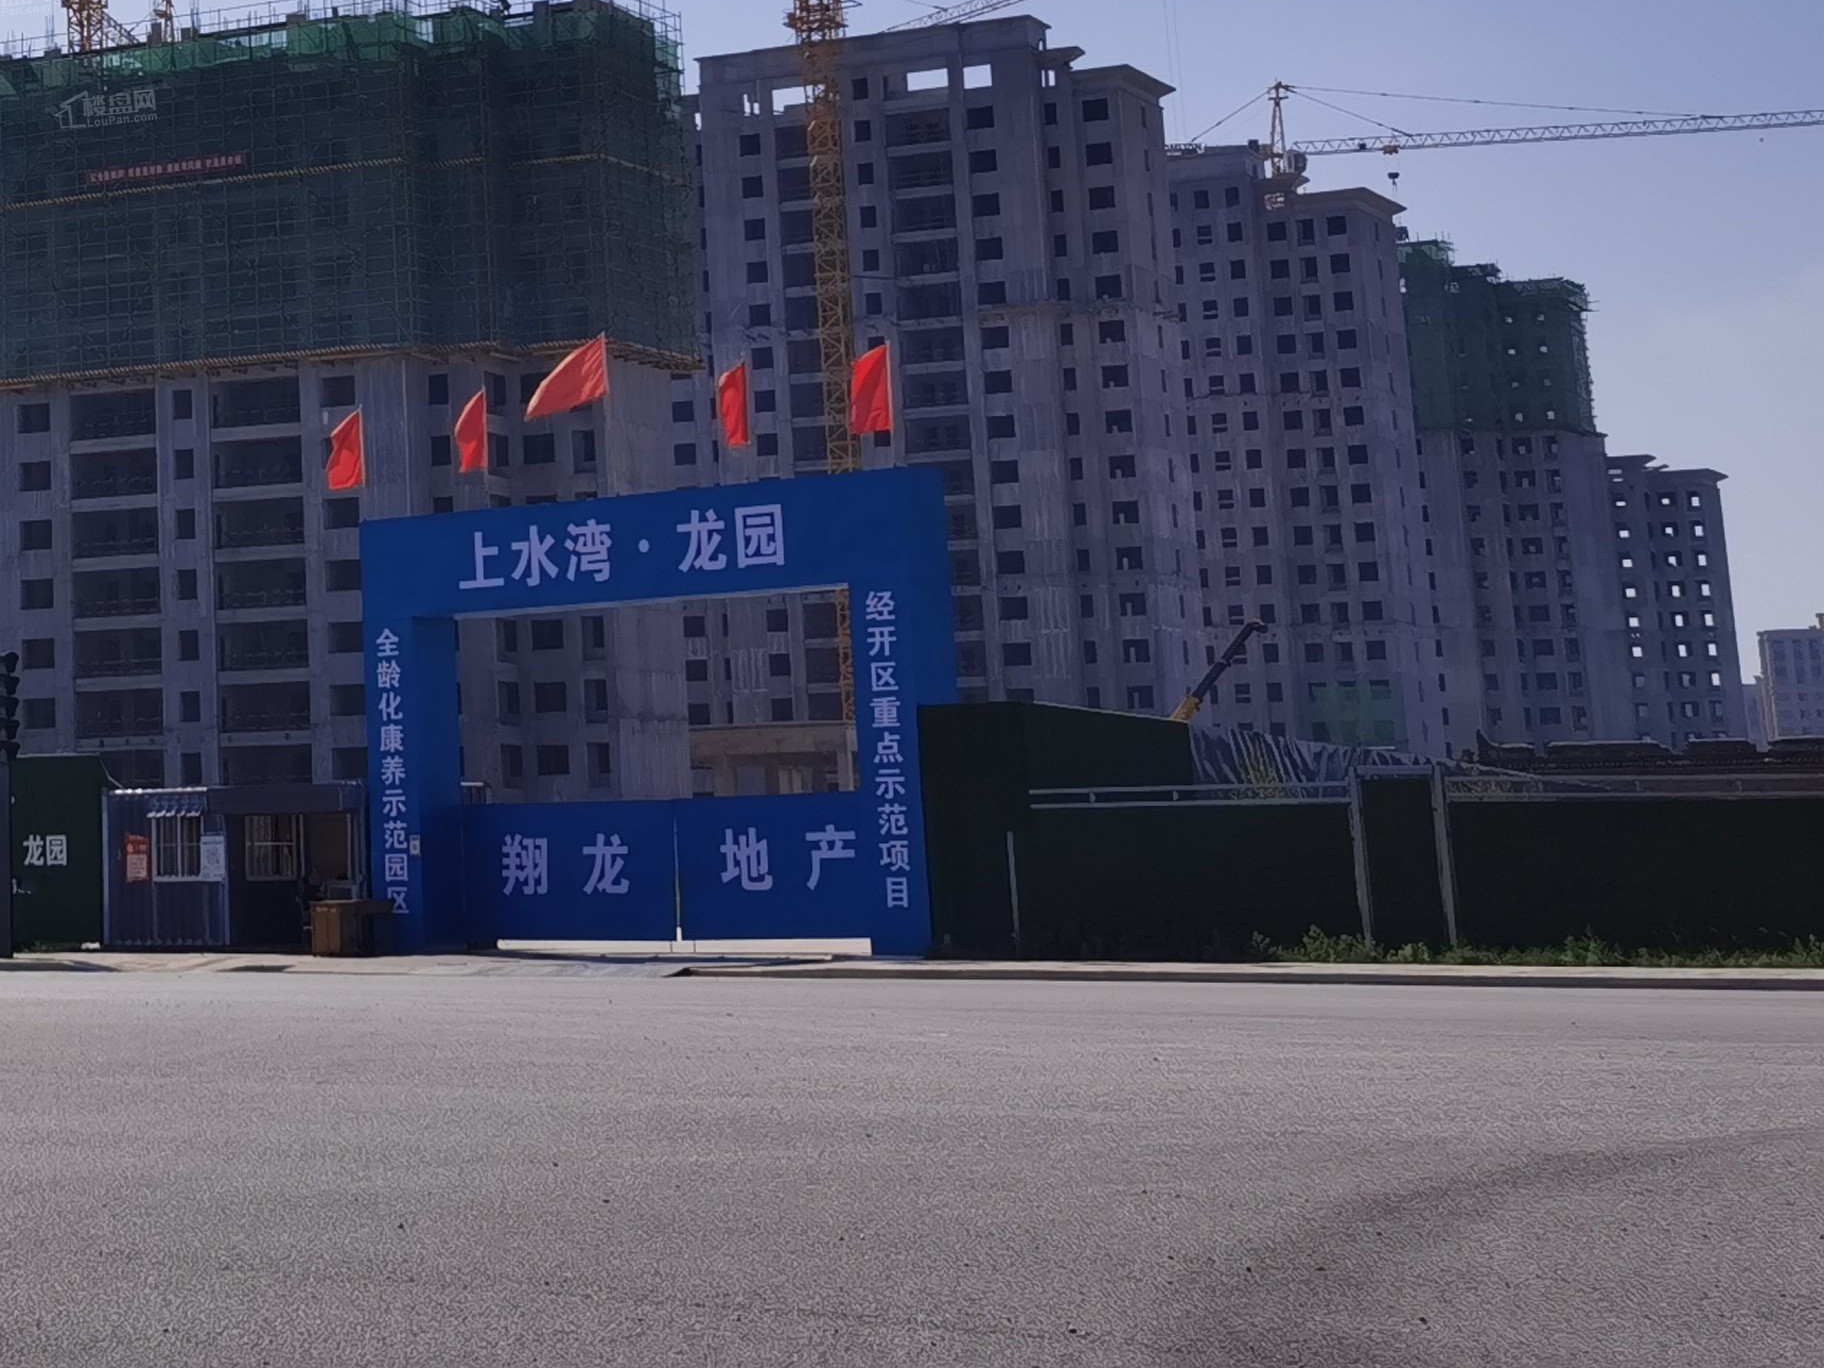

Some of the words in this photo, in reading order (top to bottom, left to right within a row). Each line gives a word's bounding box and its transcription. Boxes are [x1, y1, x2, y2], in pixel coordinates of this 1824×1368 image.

[375, 628, 410, 915] 全龄化康养示范园区
[865, 591, 911, 908] 经开区重点示范项目
